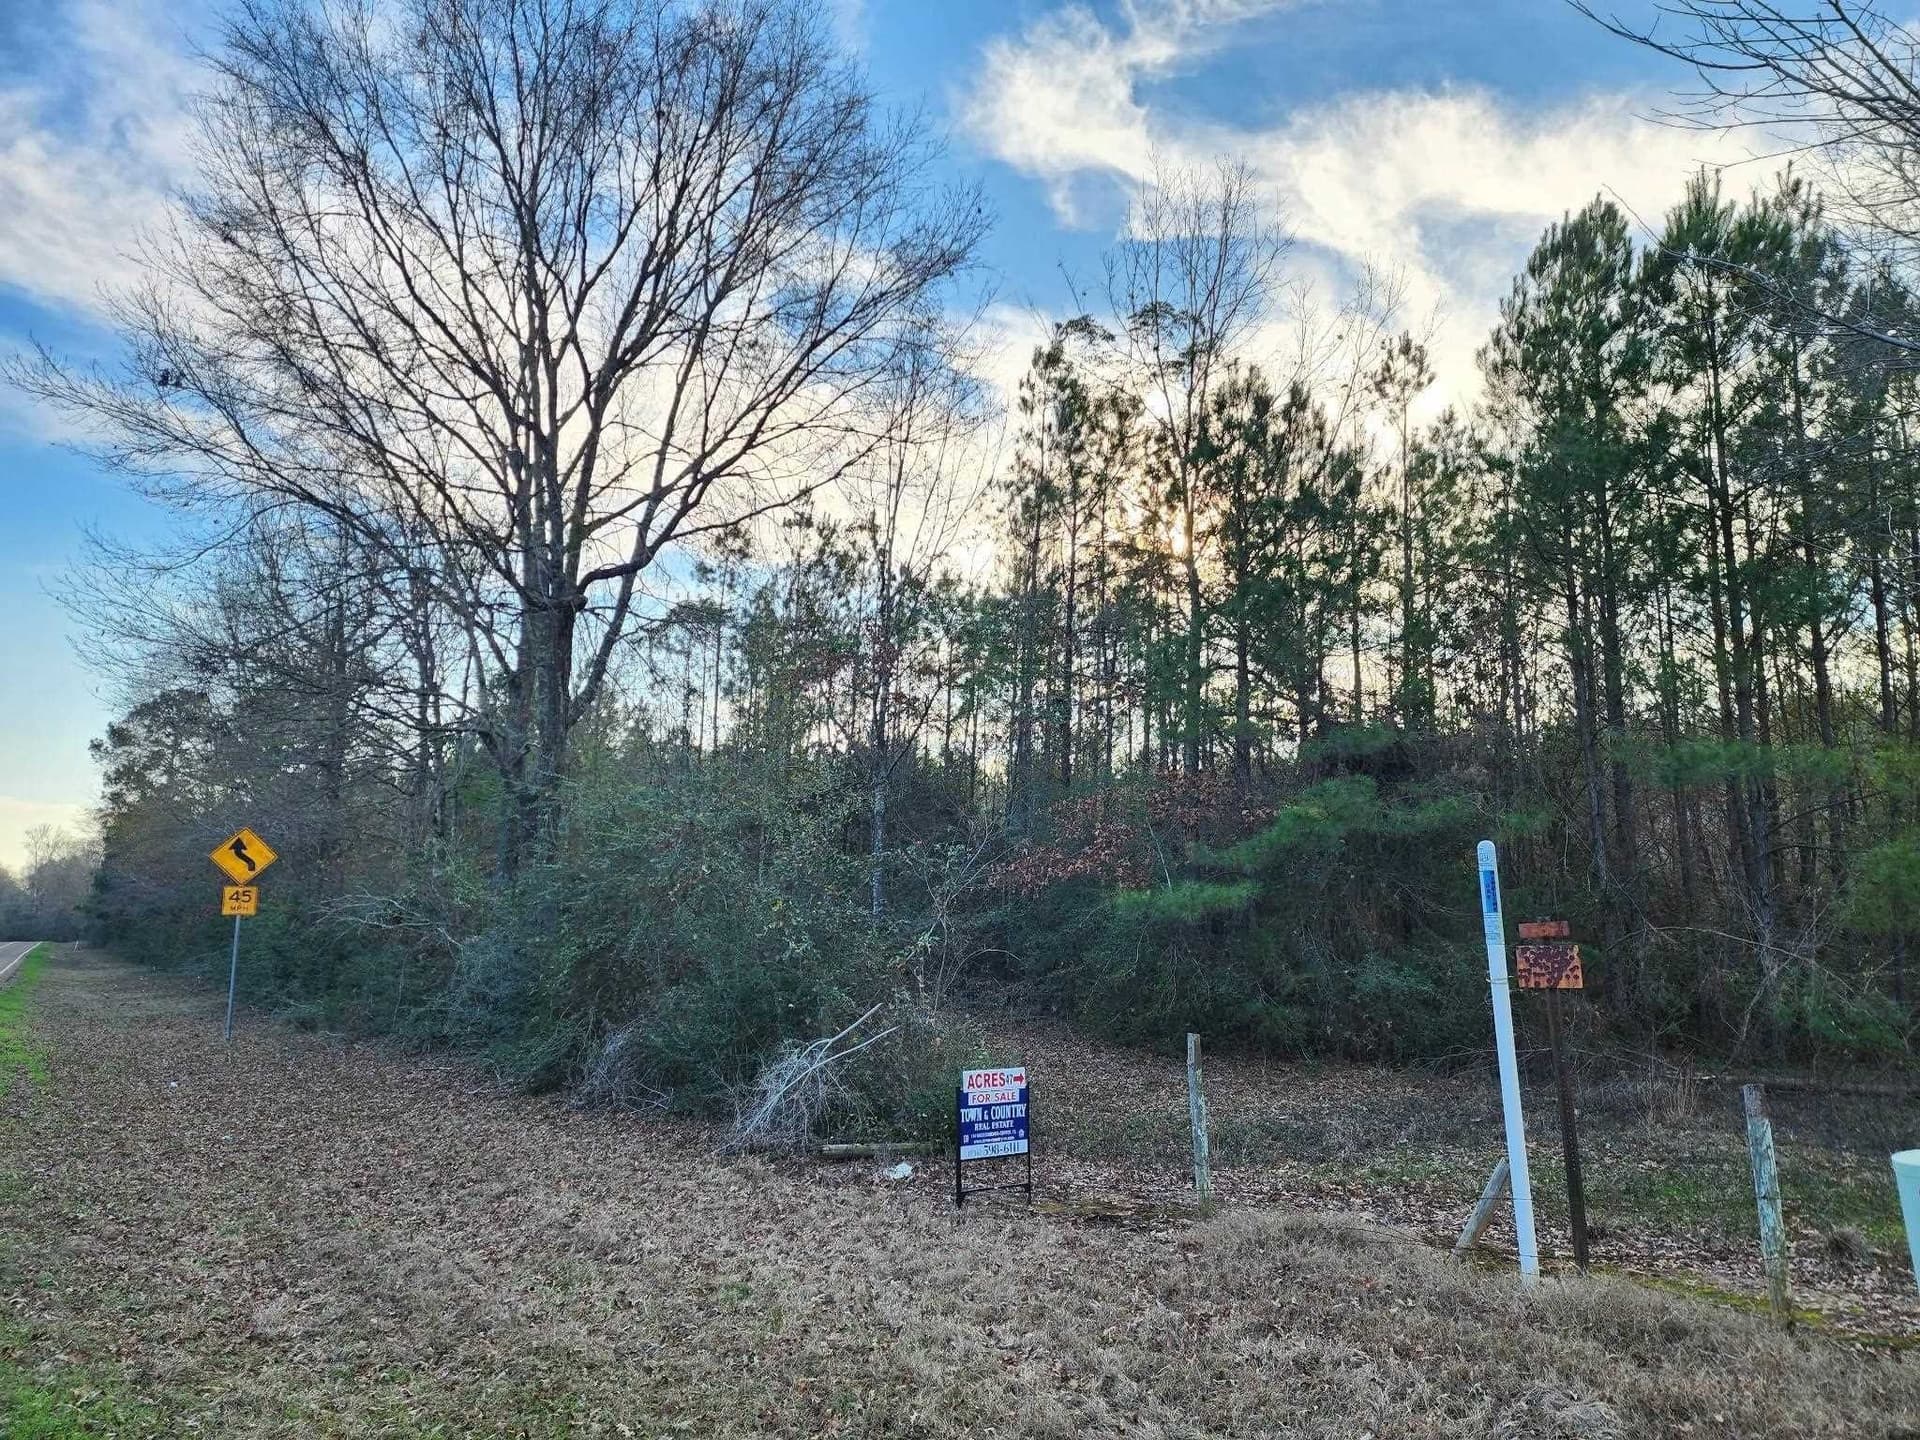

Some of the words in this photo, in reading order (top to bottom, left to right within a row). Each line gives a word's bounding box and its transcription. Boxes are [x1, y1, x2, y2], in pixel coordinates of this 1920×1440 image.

[229, 890, 252, 903] 45
[967, 1073, 1005, 1089] ACRES
[972, 1094, 991, 1103] FOR
[995, 1092, 1016, 1101] SALE
[960, 1107, 982, 1122] TOWN
[991, 1104, 1026, 1119] COUNTRY
[974, 1122, 991, 1131] REAL
[992, 1120, 1014, 1129] ESTATE
